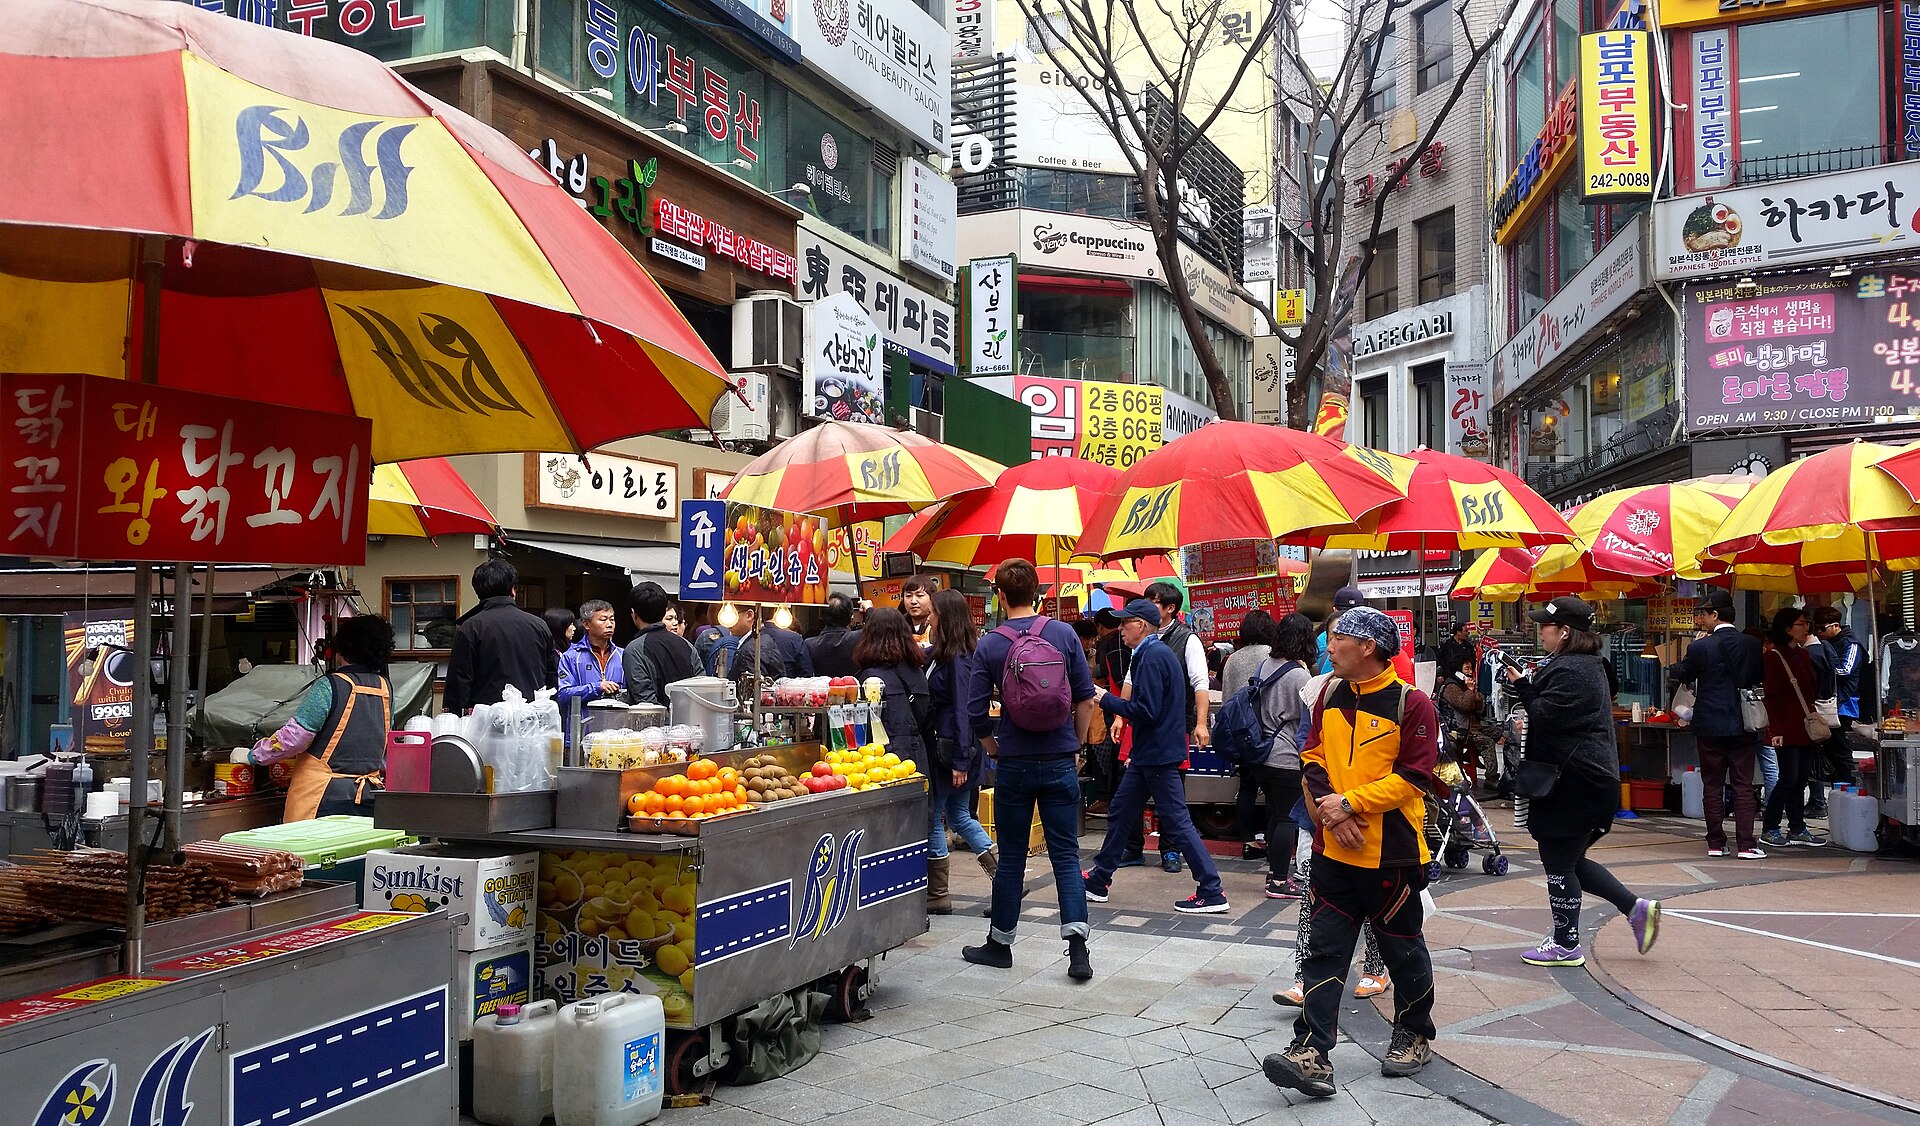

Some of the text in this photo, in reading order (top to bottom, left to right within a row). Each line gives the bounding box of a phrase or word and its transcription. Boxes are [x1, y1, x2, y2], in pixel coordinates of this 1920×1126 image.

[761, 24, 793, 54] 247-1515
[857, 1, 937, 86] 헤어펠리스
[852, 40, 940, 117] TOTAL BEAUTY SALON
[1598, 33, 1639, 166] 남포부동산
[1699, 38, 1728, 180] 남포부동산
[1038, 155, 1102, 169] Coffee & Beer
[1590, 172, 1651, 190] 242-0089
[1248, 207, 1269, 216] eicoo
[1760, 180, 1904, 243] 하카다
[659, 198, 798, 285] 월남쌈 샤브 & 샐러드바
[1069, 231, 1145, 252] Cappuccino
[1248, 269, 1270, 278] eicoo
[1668, 256, 1762, 274] JAPANESE NOODLE STYLE
[978, 268, 1003, 360] 샤브그린
[1286, 299, 1296, 319] 기원
[1734, 299, 1822, 320] 즉석에서 생면을
[1352, 311, 1454, 358] CAFEGABI
[1739, 314, 1832, 336] 직접 뽑습니다!
[823, 332, 874, 381] 샤브그린
[975, 365, 1010, 373] 254-6661
[1714, 340, 1828, 372] 특미 냉라면
[1450, 373, 1483, 386] 하카다
[1721, 366, 1849, 405] 토마토 짬뽕
[1089, 386, 1162, 417] 2층 66평
[1696, 411, 1729, 426] OPEN
[1737, 410, 1757, 423] AM
[1763, 407, 1788, 421] 9:30
[1799, 405, 1840, 419] CLOSE
[1841, 405, 1862, 418] PM
[1864, 404, 1895, 417] 11:00
[1089, 414, 1162, 443] 3층 66평
[8, 384, 74, 548] 닭꼬지
[1121, 444, 1158, 468] 60
[97, 400, 360, 547] 대왕 닭꼬지
[591, 465, 670, 512] 이화동
[688, 509, 719, 590] 쥬스
[855, 525, 881, 571] 안경
[729, 542, 820, 587] 생과일쥬스
[1224, 594, 1248, 611] 아저씨
[94, 705, 130, 719] 990원
[98, 695, 118, 704] with
[373, 864, 464, 899] Sunkist
[484, 871, 535, 894] GOLDEN
[497, 886, 535, 906] STATE
